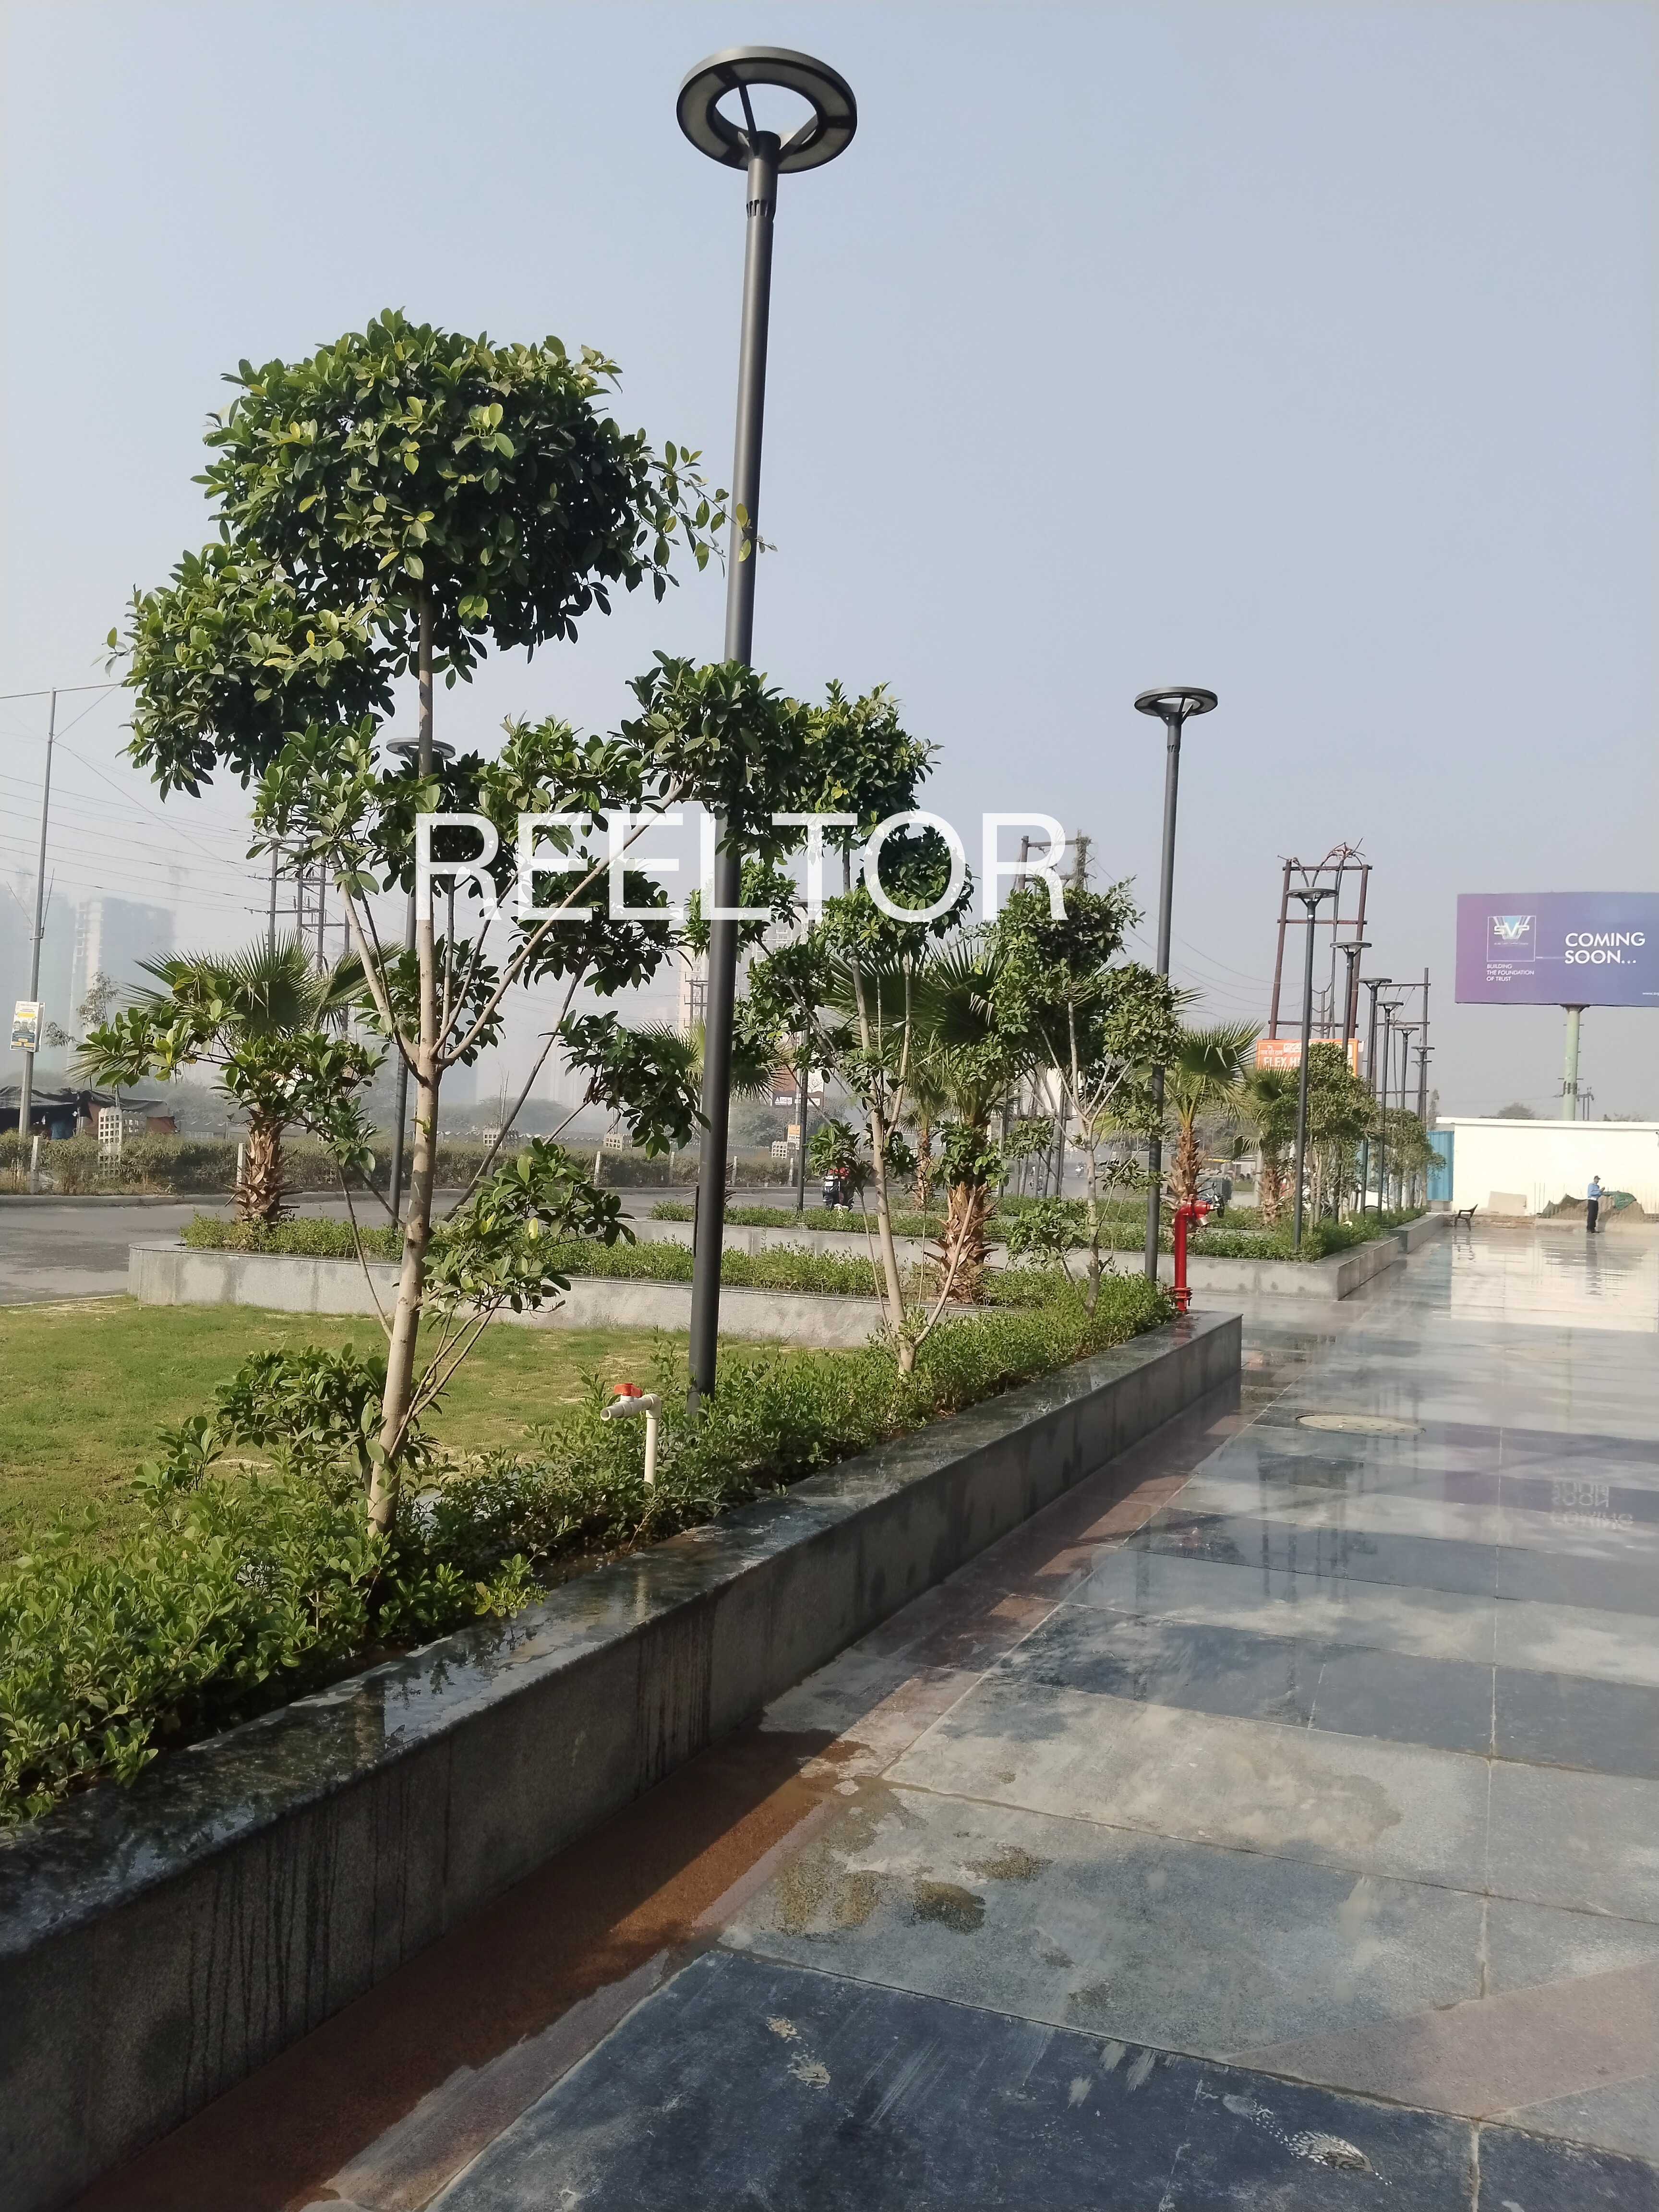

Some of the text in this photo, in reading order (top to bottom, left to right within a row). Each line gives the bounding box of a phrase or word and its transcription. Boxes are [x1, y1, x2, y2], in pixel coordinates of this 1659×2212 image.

[1493, 922, 1530, 940] SVP
[1565, 932, 1646, 947] COMING
[1564, 950, 1636, 964] SOON...
[1263, 1056, 1287, 1067] FLEX
